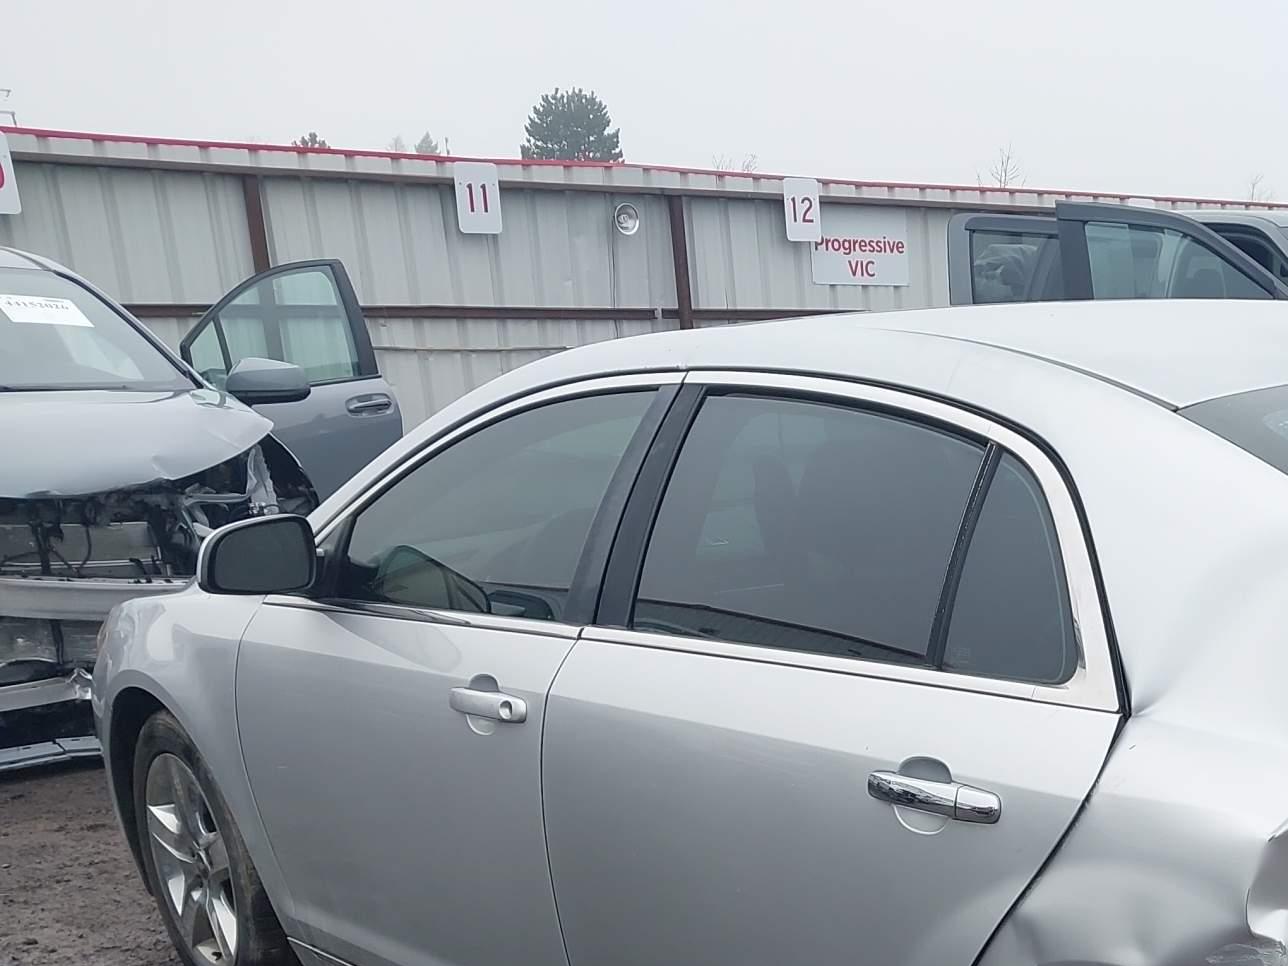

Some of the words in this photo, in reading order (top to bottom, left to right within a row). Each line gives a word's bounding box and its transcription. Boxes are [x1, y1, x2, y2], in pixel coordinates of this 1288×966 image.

[466, 183, 489, 213] 11
[791, 196, 814, 223] 12
[848, 260, 875, 277] VIC
